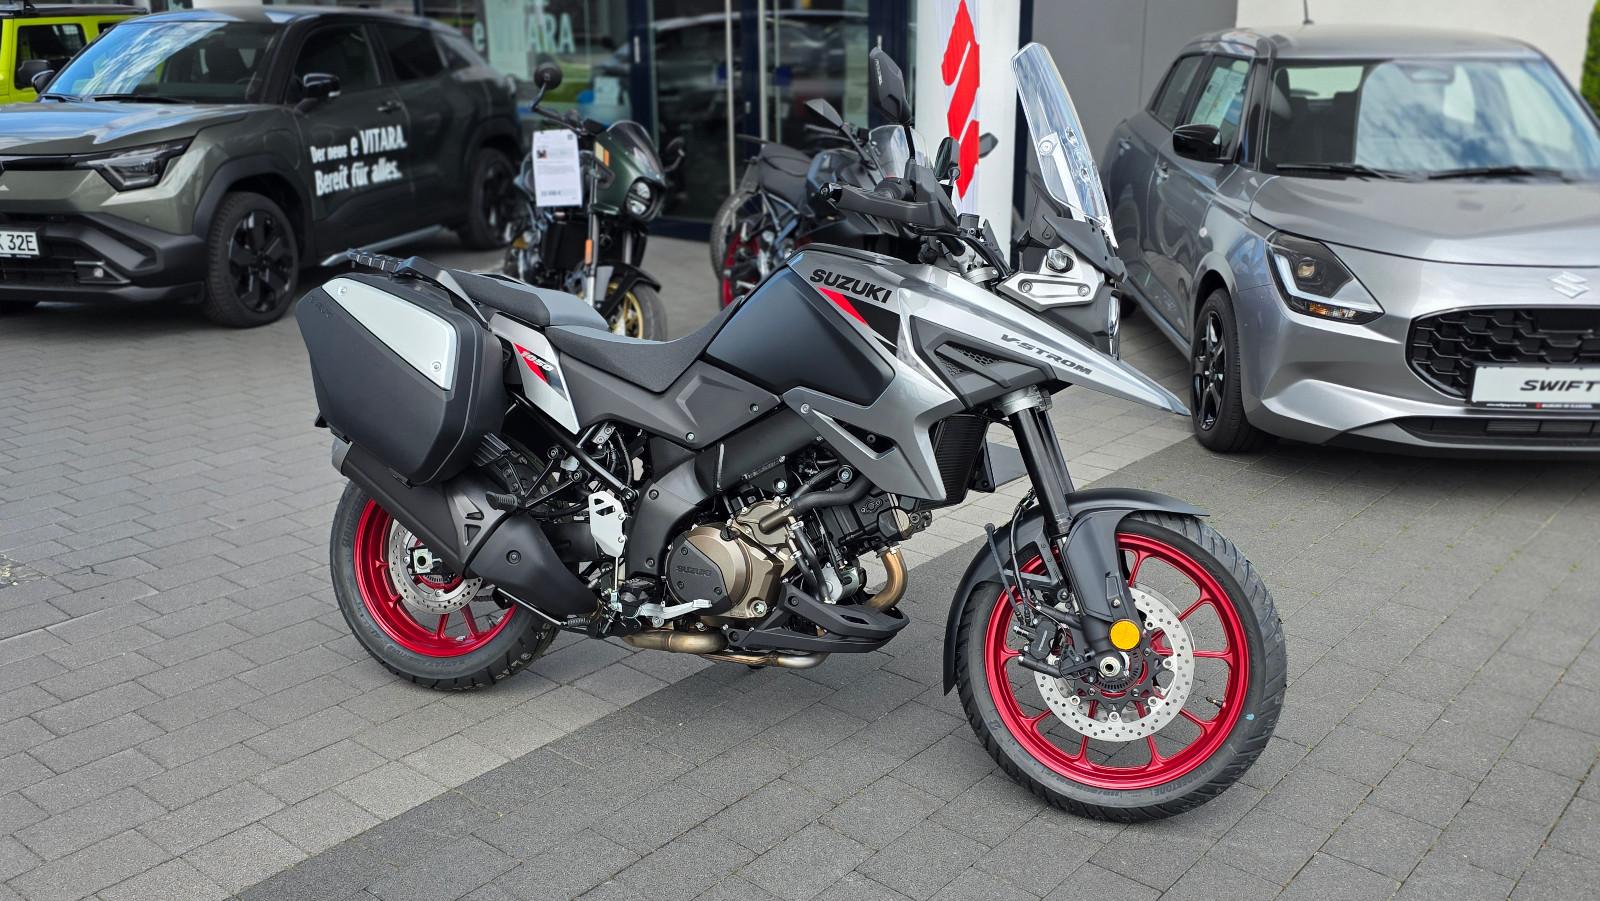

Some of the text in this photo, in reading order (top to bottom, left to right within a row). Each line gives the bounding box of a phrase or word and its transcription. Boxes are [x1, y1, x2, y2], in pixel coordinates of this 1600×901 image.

[310, 124, 408, 164] Der neue e VITARA.
[314, 156, 402, 197] Bereit für alles.
[809, 268, 893, 304] SUZUKI
[1001, 333, 1093, 375] V-STROM
[1520, 380, 1600, 392] SWIFT
